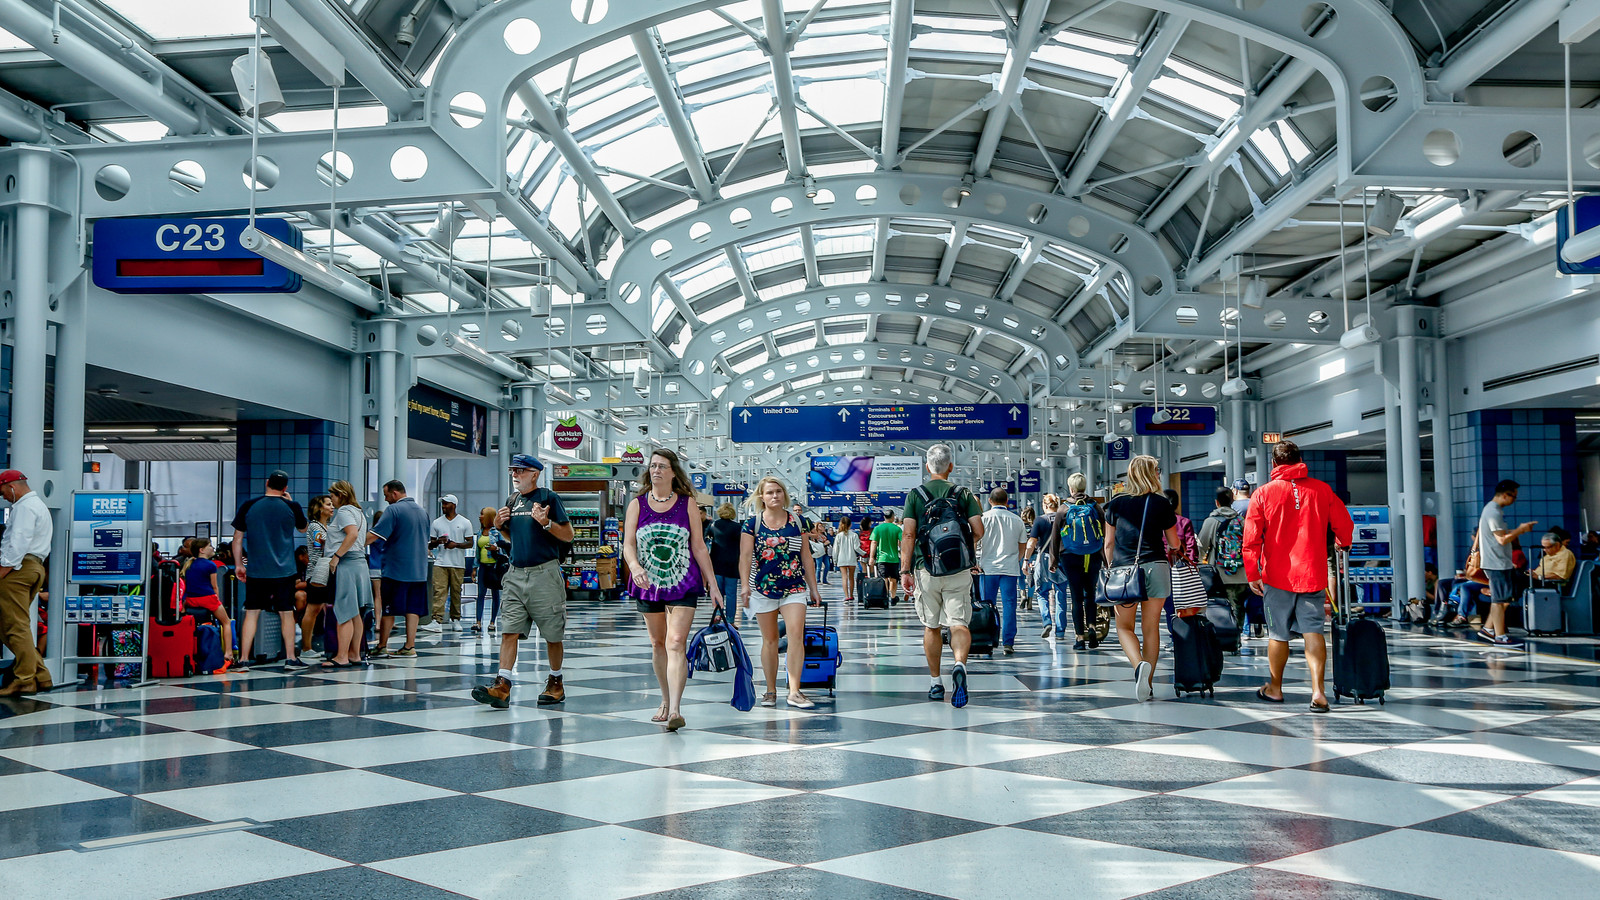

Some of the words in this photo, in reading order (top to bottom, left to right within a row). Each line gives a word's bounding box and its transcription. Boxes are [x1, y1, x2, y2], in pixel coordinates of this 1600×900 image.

[155, 224, 226, 252] C23
[439, 409, 450, 422] Chicago
[1263, 433, 1280, 442] EXIT
[92, 498, 127, 510] FREE
